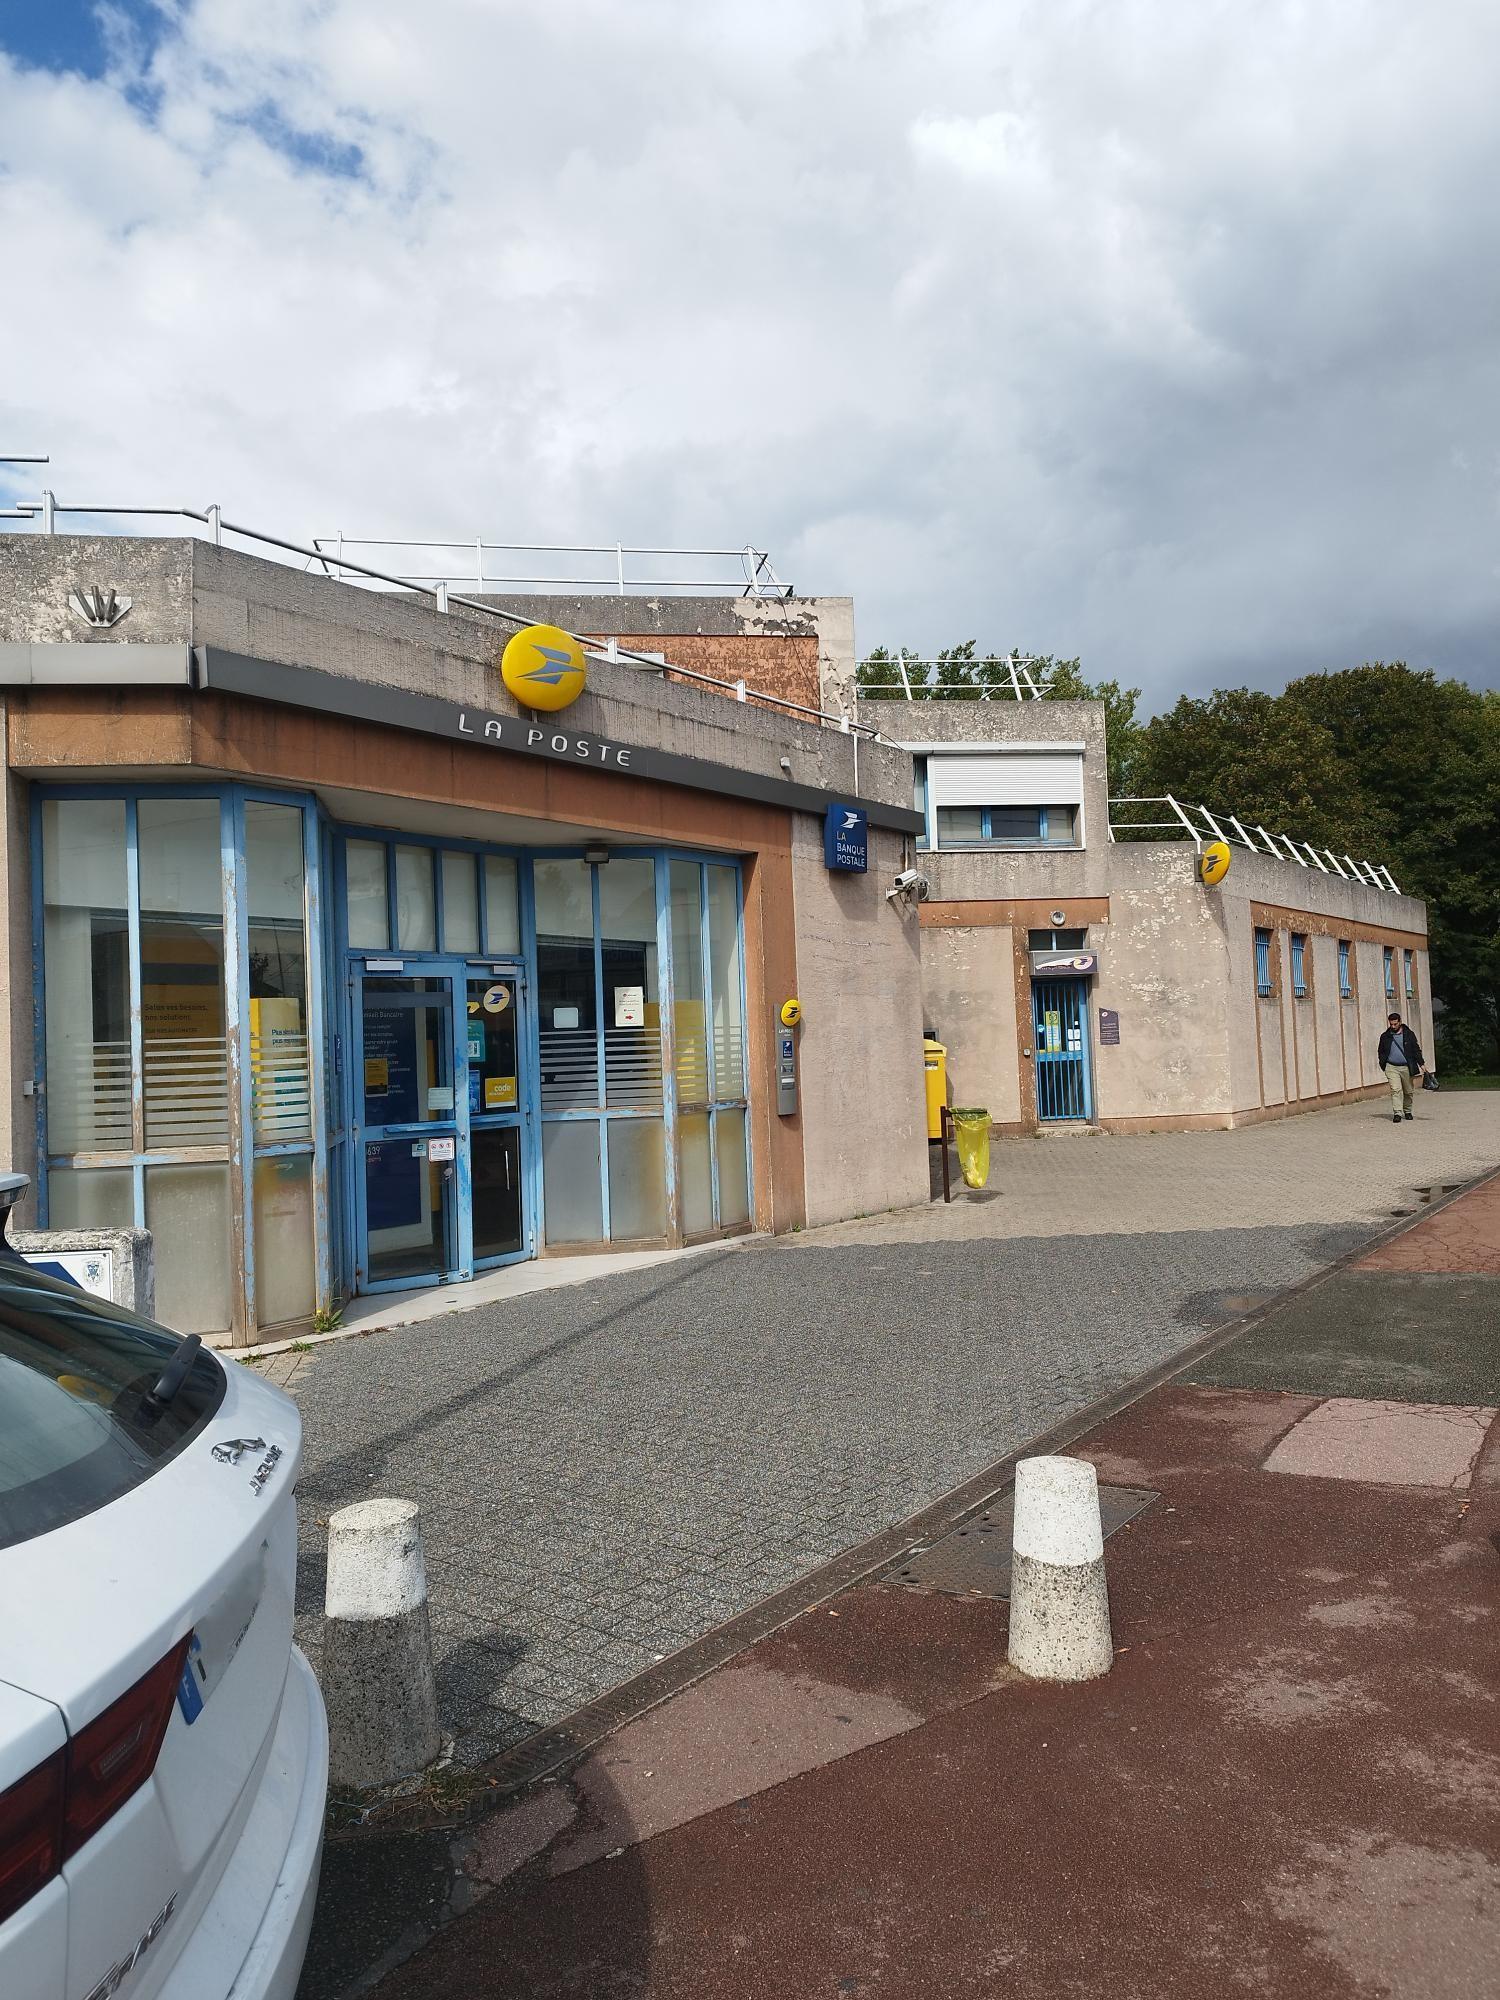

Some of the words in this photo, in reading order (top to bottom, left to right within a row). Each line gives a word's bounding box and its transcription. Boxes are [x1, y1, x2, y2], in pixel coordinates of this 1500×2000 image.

[458, 713, 502, 739] LA
[527, 729, 632, 767] POSTE
[836, 831, 847, 841] LA
[836, 843, 866, 856] BANQUE
[836, 854, 866, 868] POSTALE
[494, 1083, 511, 1092] code
[182, 1675, 191, 1698] F
